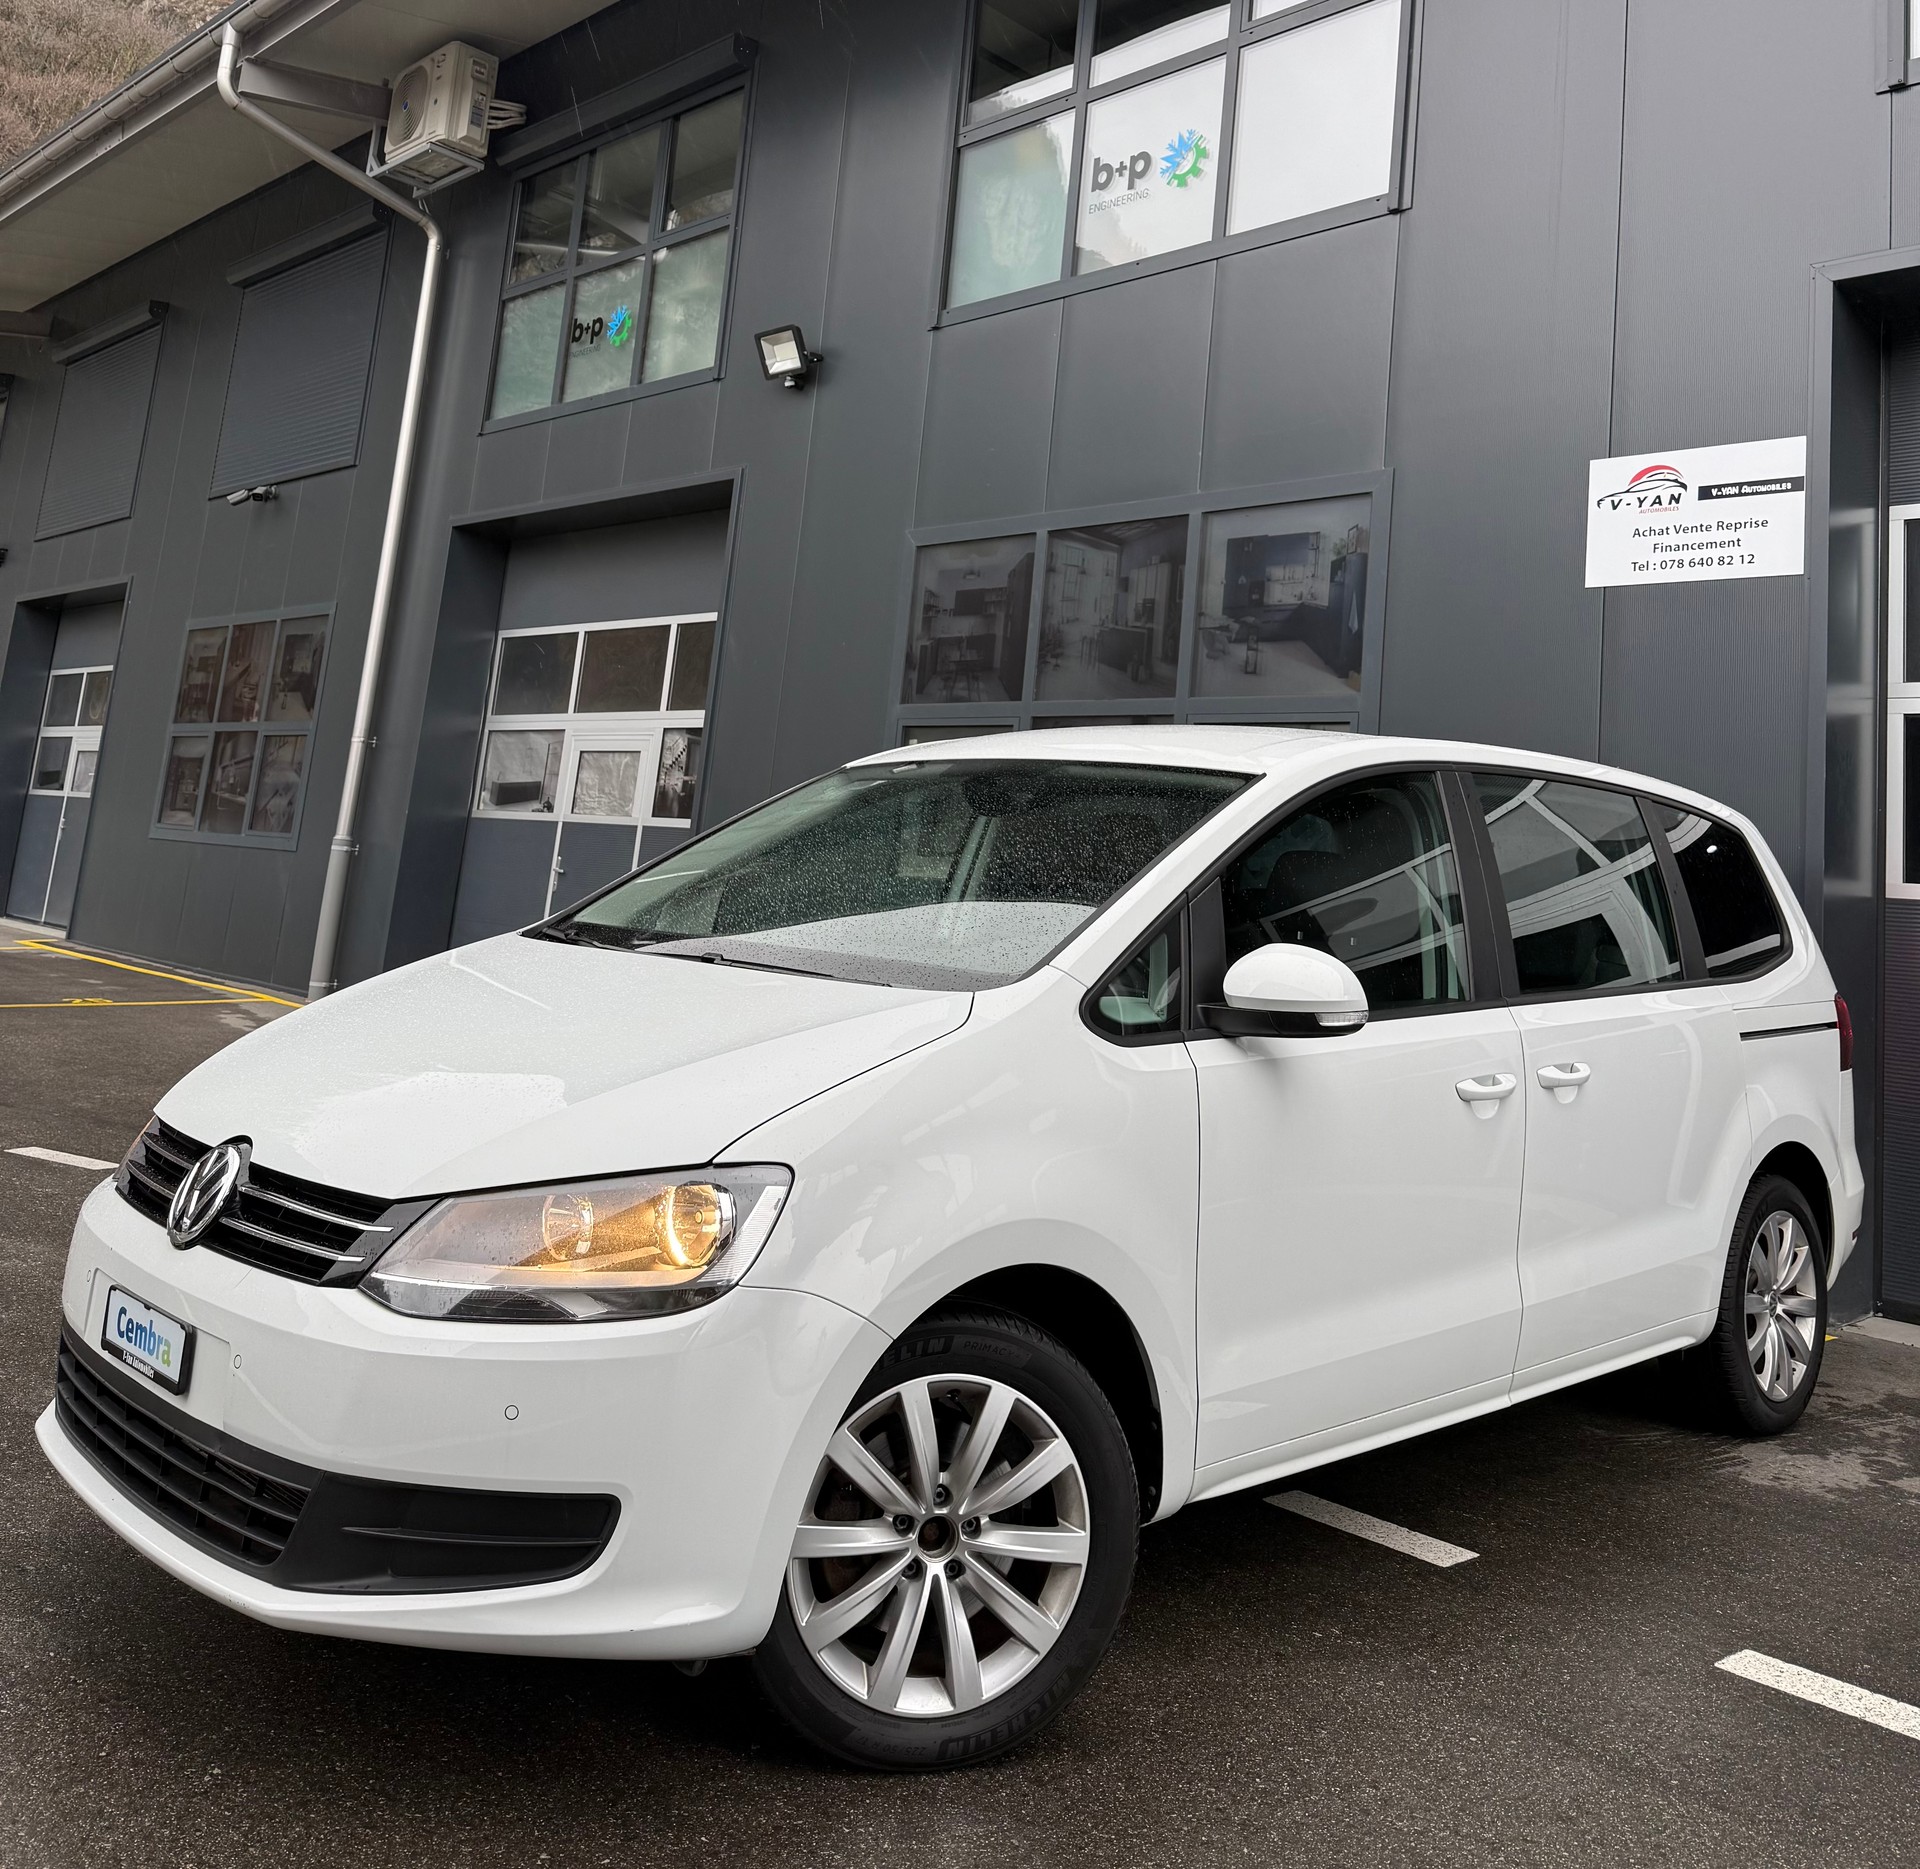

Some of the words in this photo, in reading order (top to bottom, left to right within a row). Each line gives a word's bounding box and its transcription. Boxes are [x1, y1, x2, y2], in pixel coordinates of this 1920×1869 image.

[1091, 151, 1152, 192] b+p
[1088, 188, 1150, 215] ENGINEERING
[571, 317, 604, 345] b+p
[1610, 493, 1682, 511] V-YAN
[1711, 486, 1739, 497] V-YAN
[1638, 506, 1680, 515] AUTOMOBILES
[1632, 526, 1670, 538] Achat
[1673, 523, 1712, 535] Vente
[1716, 517, 1769, 533] Reprise
[1653, 537, 1742, 554] Financement
[1631, 560, 1649, 572] Tel
[1660, 558, 1684, 570] 078
[1688, 556, 1714, 568] 640
[1717, 554, 1734, 566] 82
[1739, 553, 1755, 565] 12
[117, 1306, 171, 1368] Cembra
[947, 1671, 1072, 1758] MICHELIN
